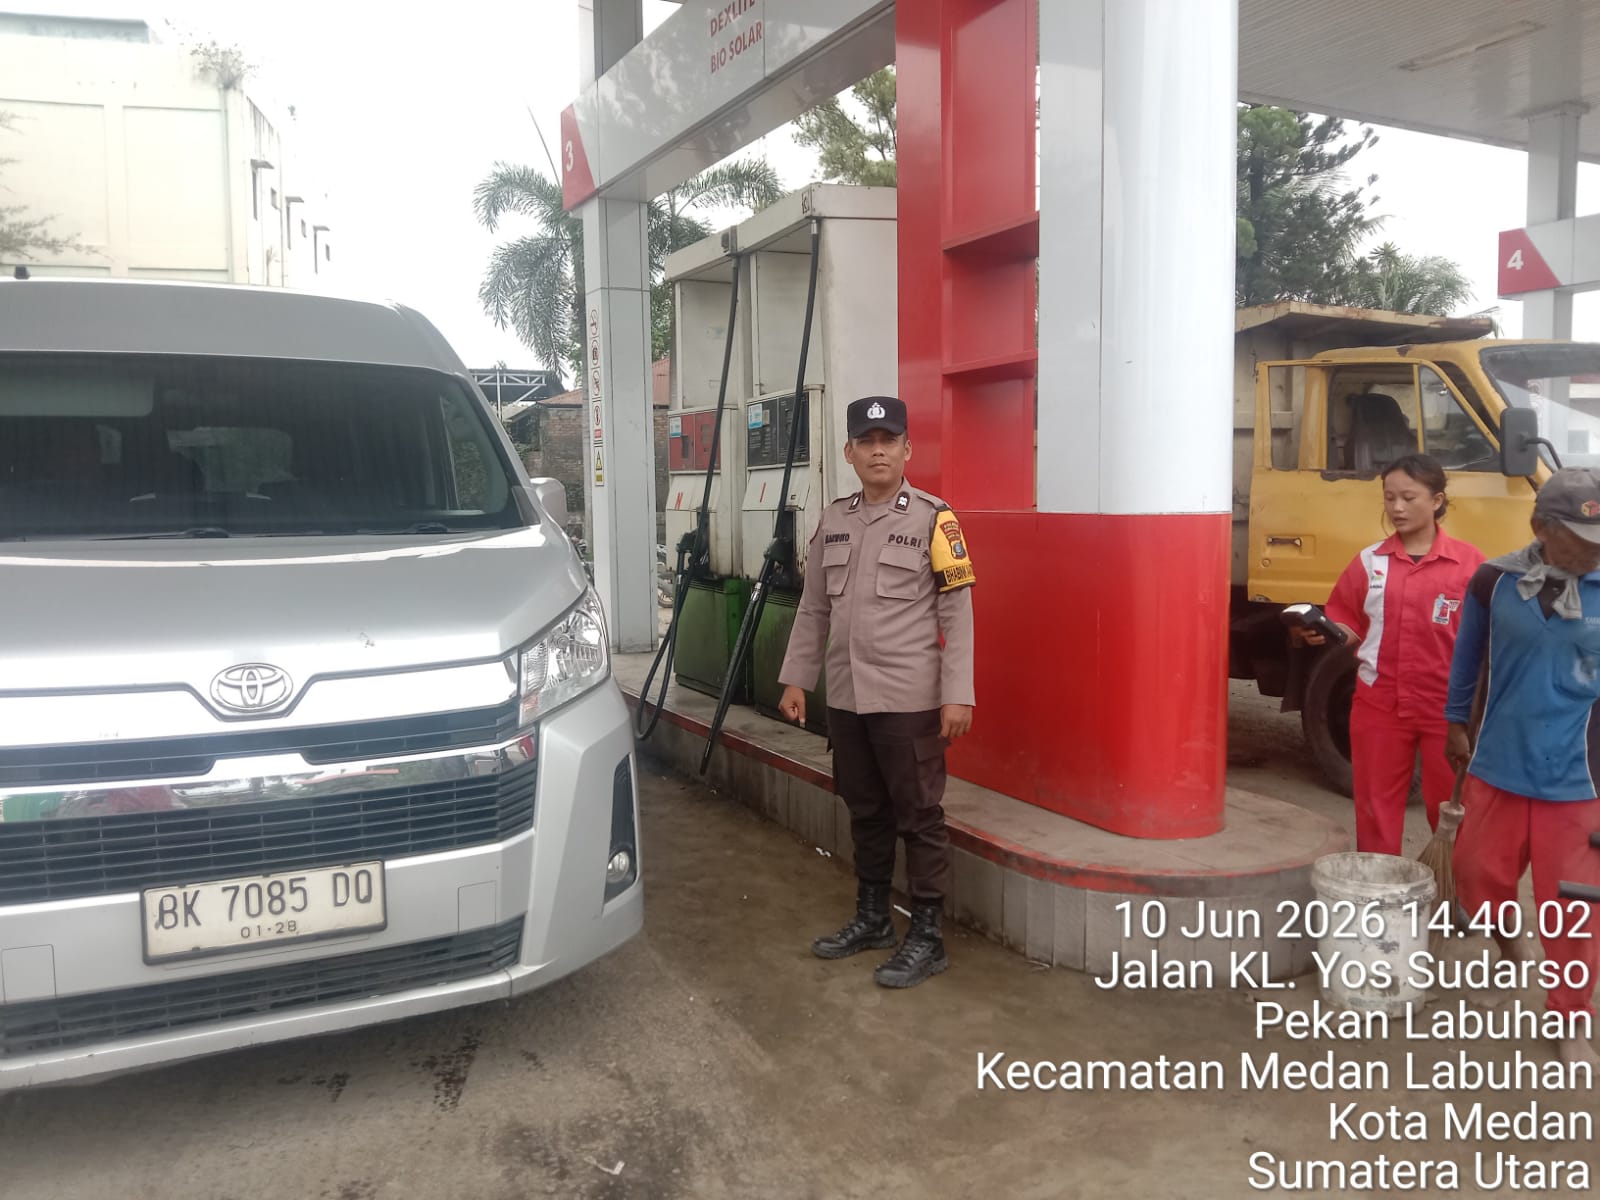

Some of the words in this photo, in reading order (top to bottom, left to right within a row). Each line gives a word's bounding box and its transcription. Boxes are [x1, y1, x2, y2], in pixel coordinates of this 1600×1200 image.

[711, 47, 727, 74] BIO
[729, 20, 763, 61] SOLAR
[565, 140, 574, 172] 3
[1506, 249, 1525, 271] 4
[887, 533, 922, 549] POLRI
[155, 888, 202, 931] BK
[220, 876, 309, 923] 7085
